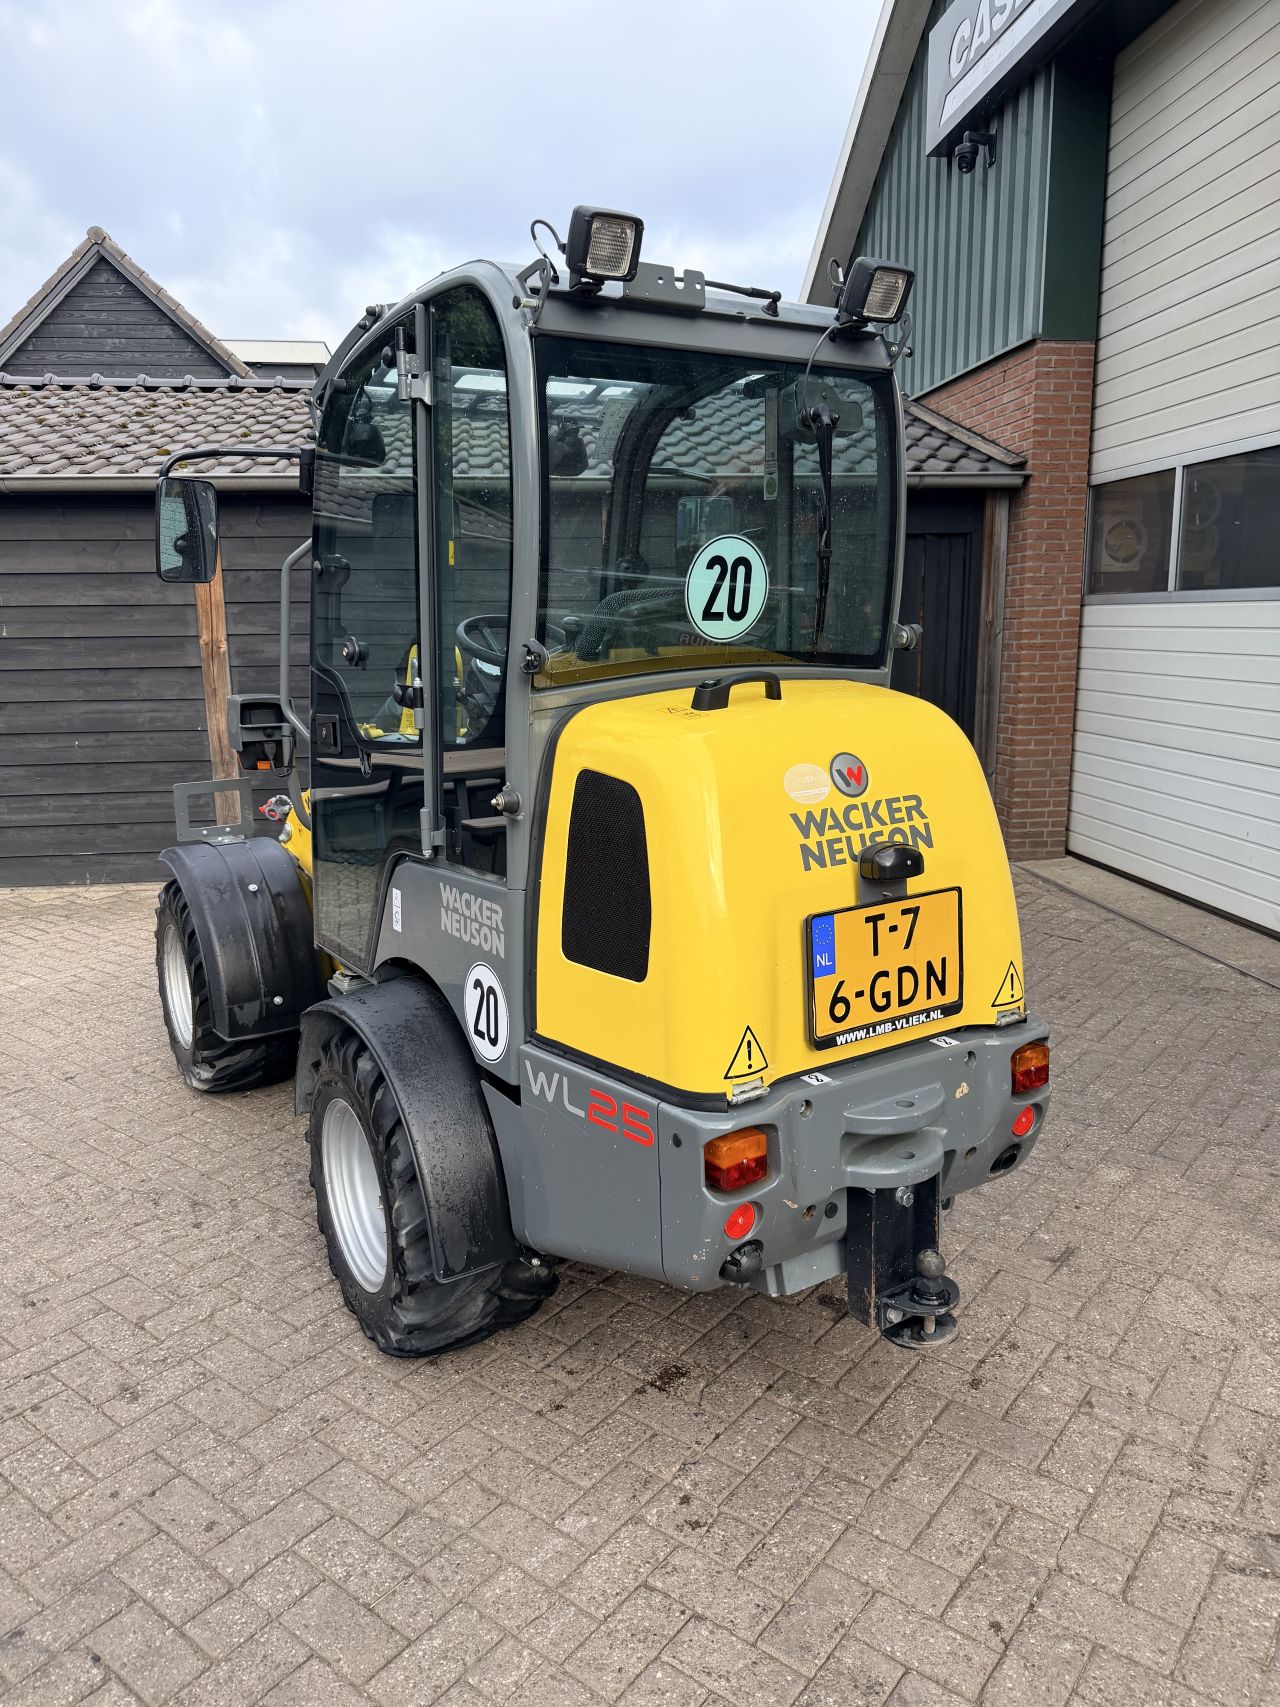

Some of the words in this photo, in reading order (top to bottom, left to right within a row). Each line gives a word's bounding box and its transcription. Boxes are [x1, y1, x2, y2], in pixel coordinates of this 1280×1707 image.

[949, 0, 1021, 78] CAS
[702, 555, 752, 622] 20
[789, 794, 928, 839] WACKER
[439, 882, 504, 932] WACKER
[440, 907, 504, 959] NEUSON
[865, 906, 920, 956] T-7
[816, 953, 832, 968] NL
[473, 978, 499, 1047] 20
[829, 957, 947, 1023] 6-GDN
[836, 1010, 944, 1045] WWW.LMB-VLIEK.NL
[525, 1060, 655, 1147] WL25
